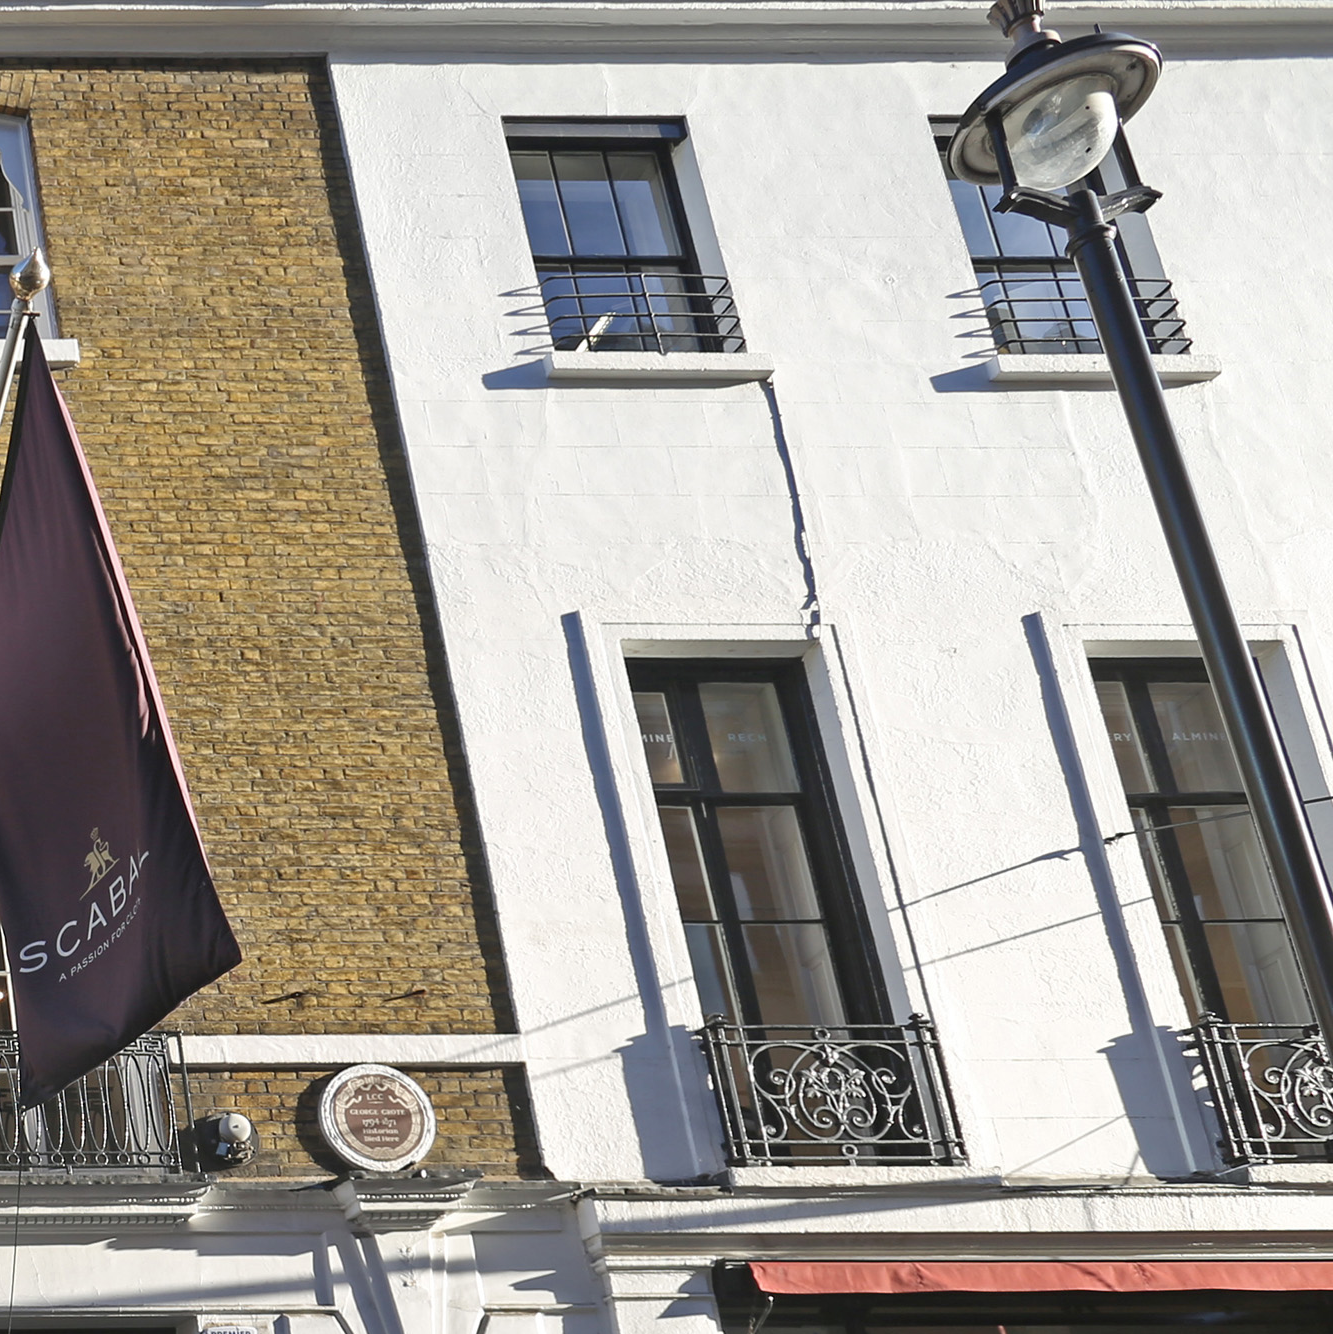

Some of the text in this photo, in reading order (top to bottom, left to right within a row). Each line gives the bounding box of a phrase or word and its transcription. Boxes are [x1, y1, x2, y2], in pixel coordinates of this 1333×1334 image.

[19, 850, 149, 973] SCABAL
[59, 973, 67, 982] A
[71, 939, 110, 976] PASSION
[111, 922, 126, 943] FOR
